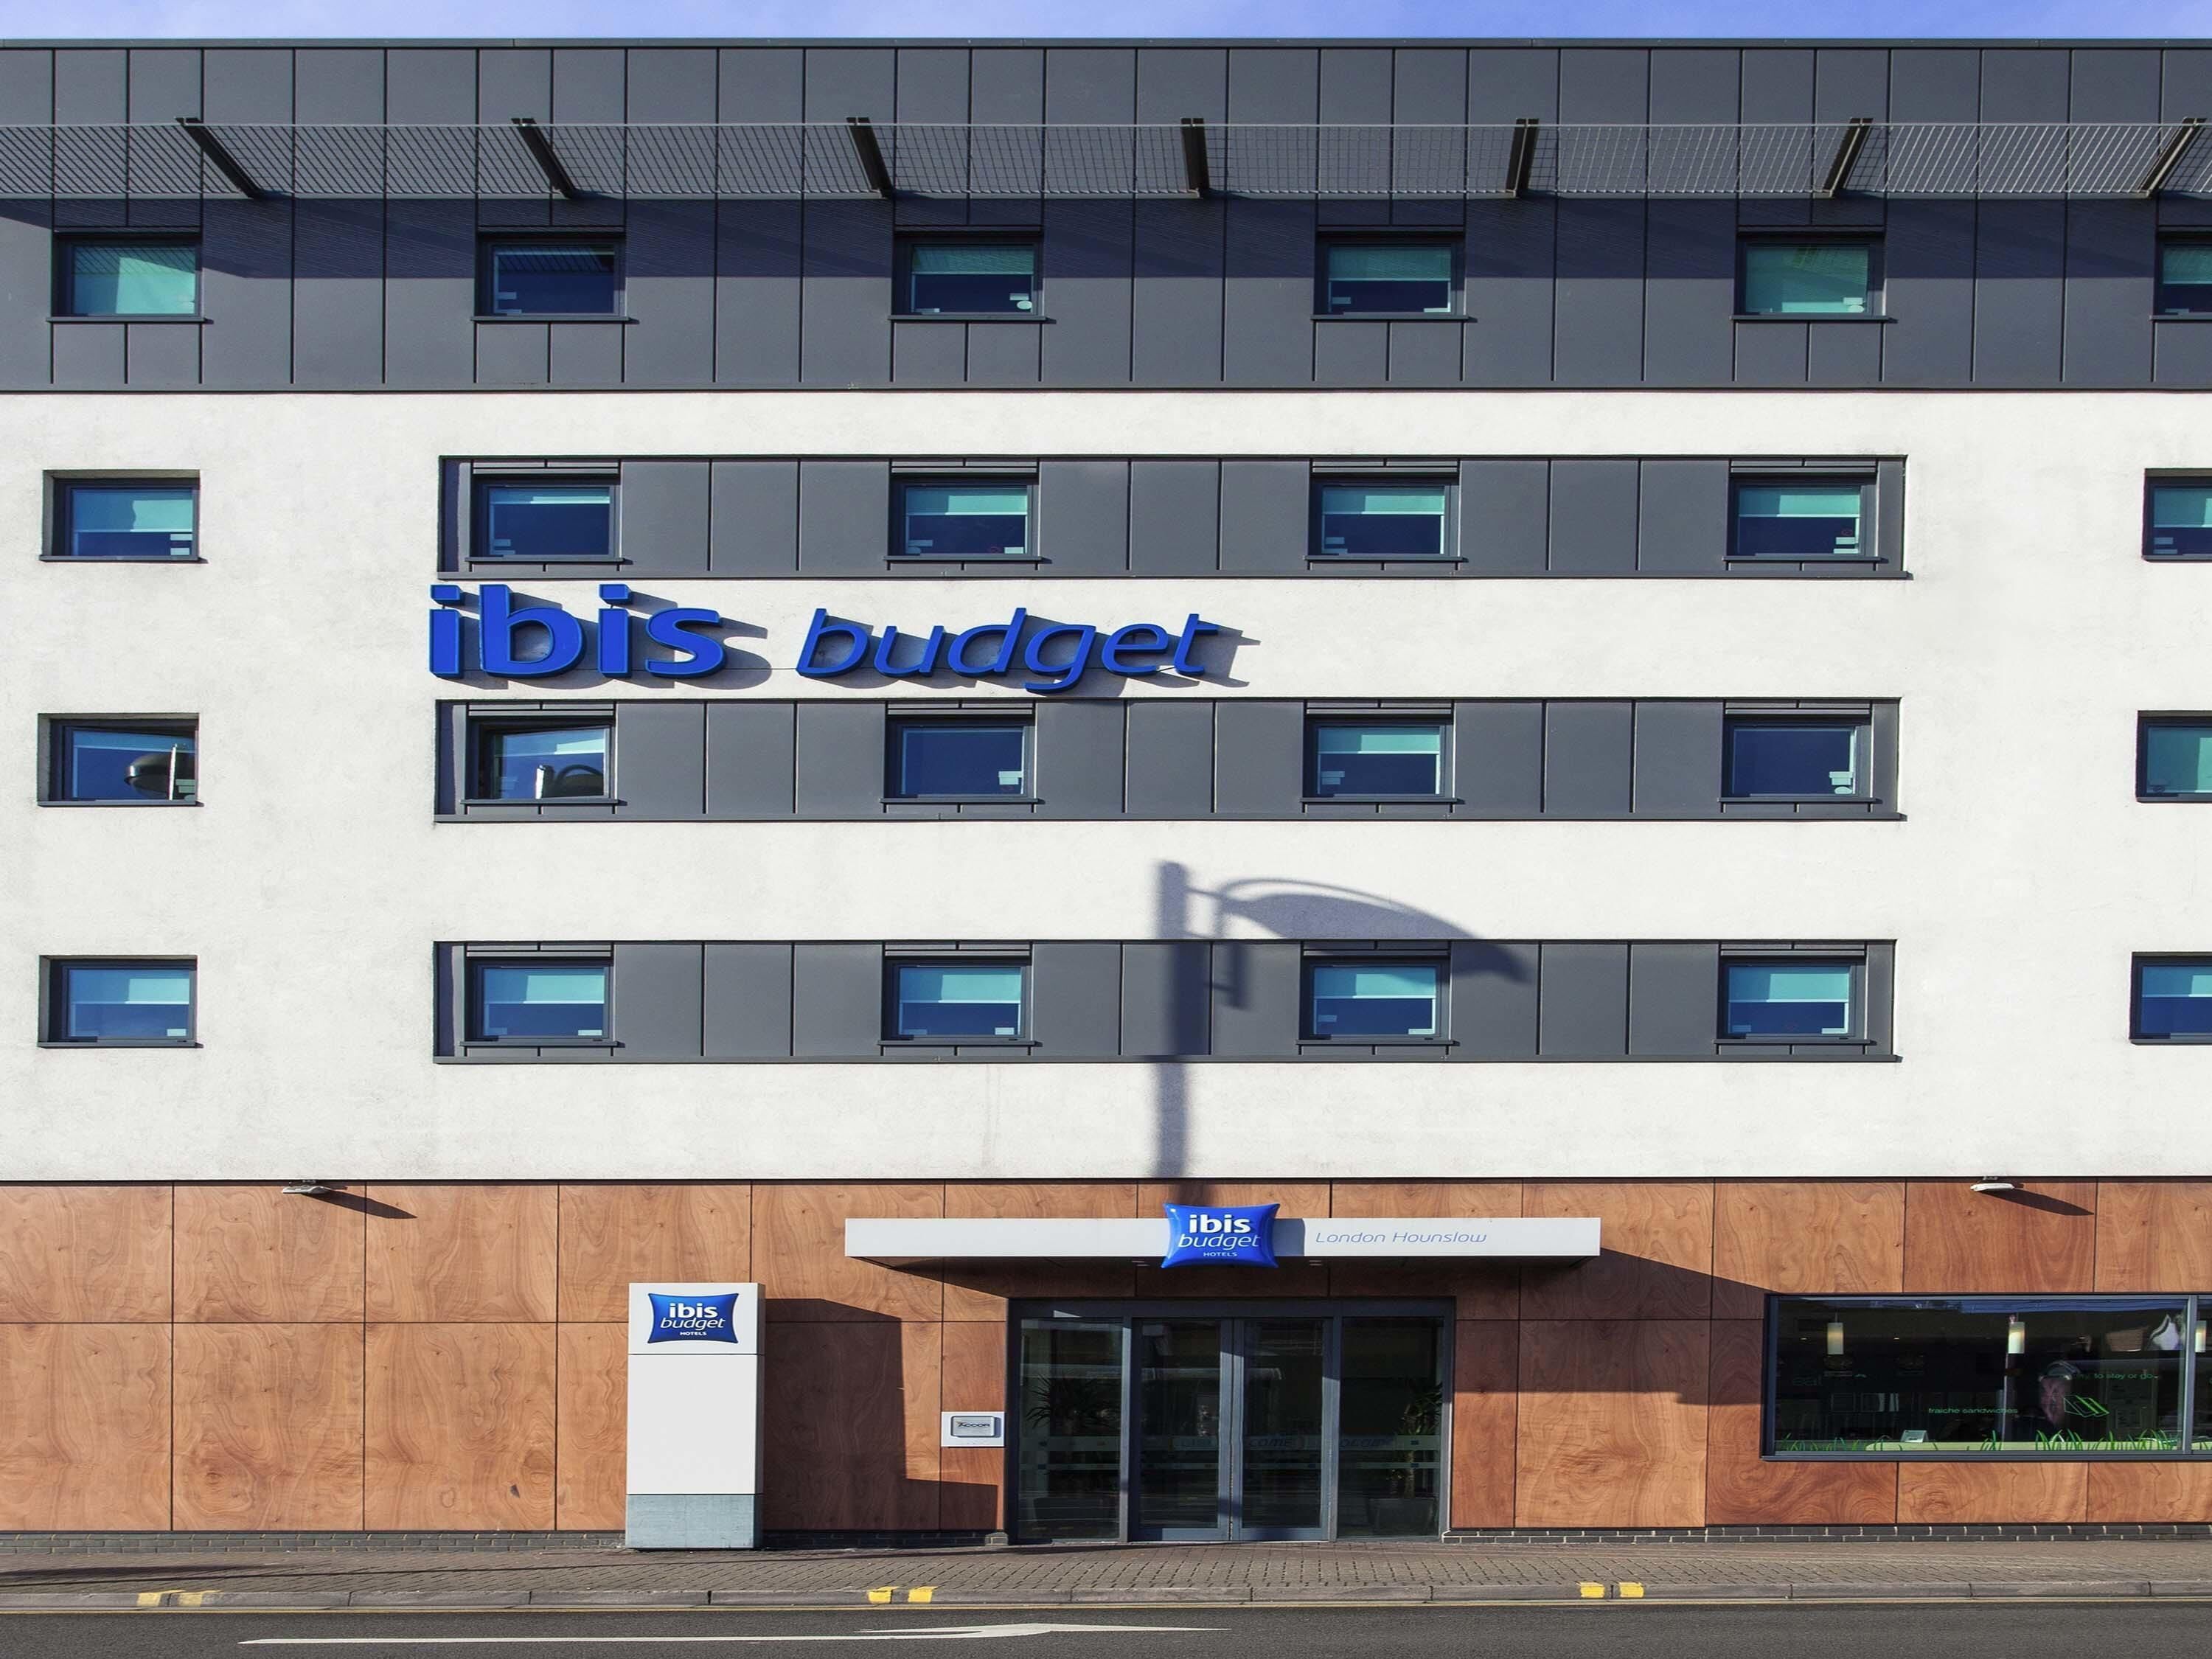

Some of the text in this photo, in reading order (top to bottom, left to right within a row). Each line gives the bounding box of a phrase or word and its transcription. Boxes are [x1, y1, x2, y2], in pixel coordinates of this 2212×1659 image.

[429, 584, 1218, 693] ibis budget
[1189, 1214, 1251, 1234] ibis
[1178, 1234, 1261, 1251] budget
[1315, 1232, 1487, 1243] London Hounslow
[669, 1303, 718, 1318] ibis
[660, 1318, 726, 1331] budget
